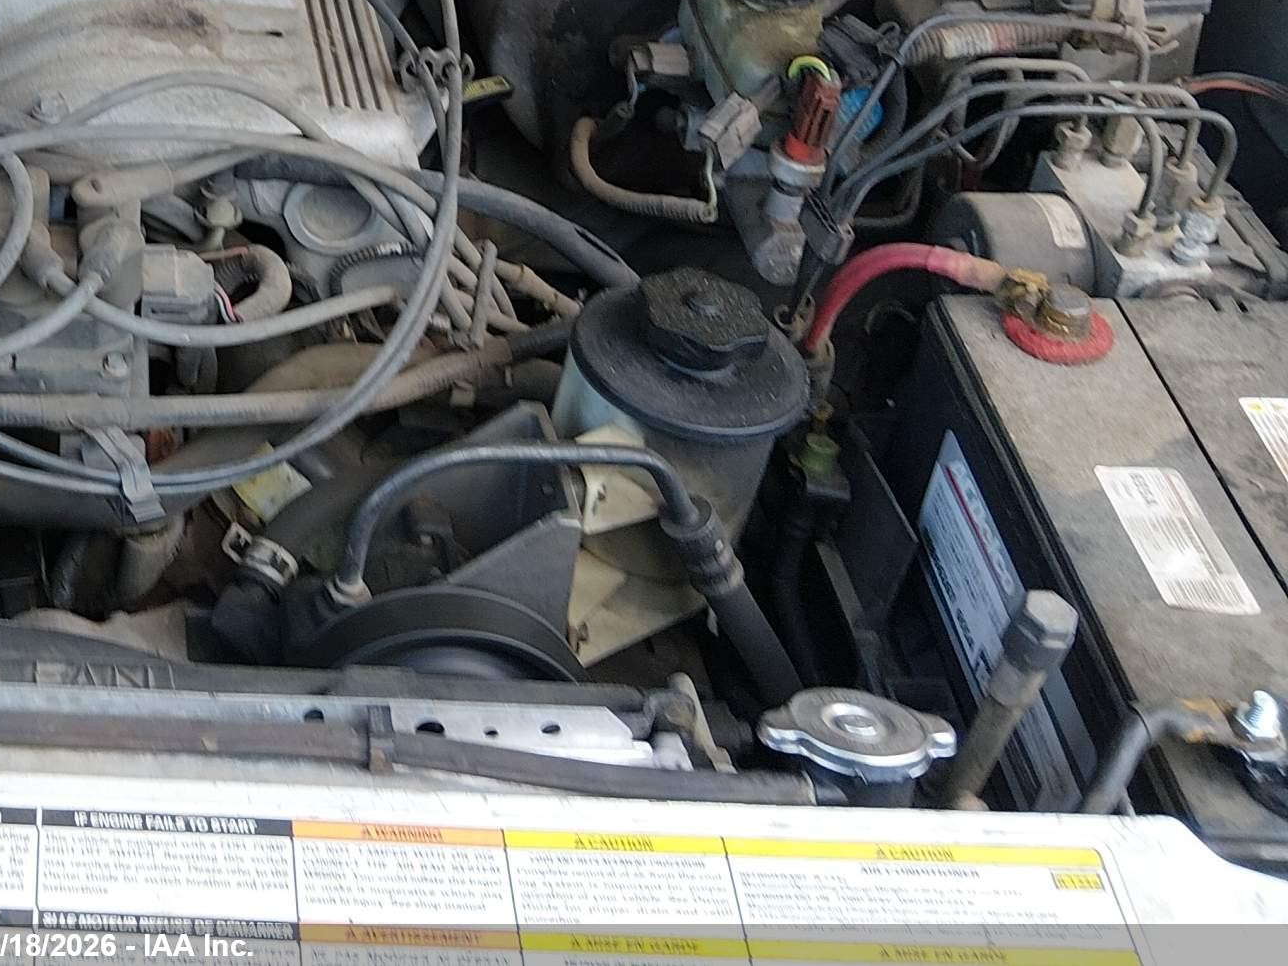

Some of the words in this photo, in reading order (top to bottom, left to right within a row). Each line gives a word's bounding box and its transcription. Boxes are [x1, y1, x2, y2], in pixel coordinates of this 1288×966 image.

[74, 811, 88, 827] IF
[89, 811, 143, 830] ENGINE
[145, 813, 186, 832] FAILS
[188, 816, 209, 833] TO
[210, 817, 258, 834] START
[374, 826, 443, 843] WARNING
[587, 834, 655, 852] CAUTION
[890, 846, 955, 863] CAUTION
